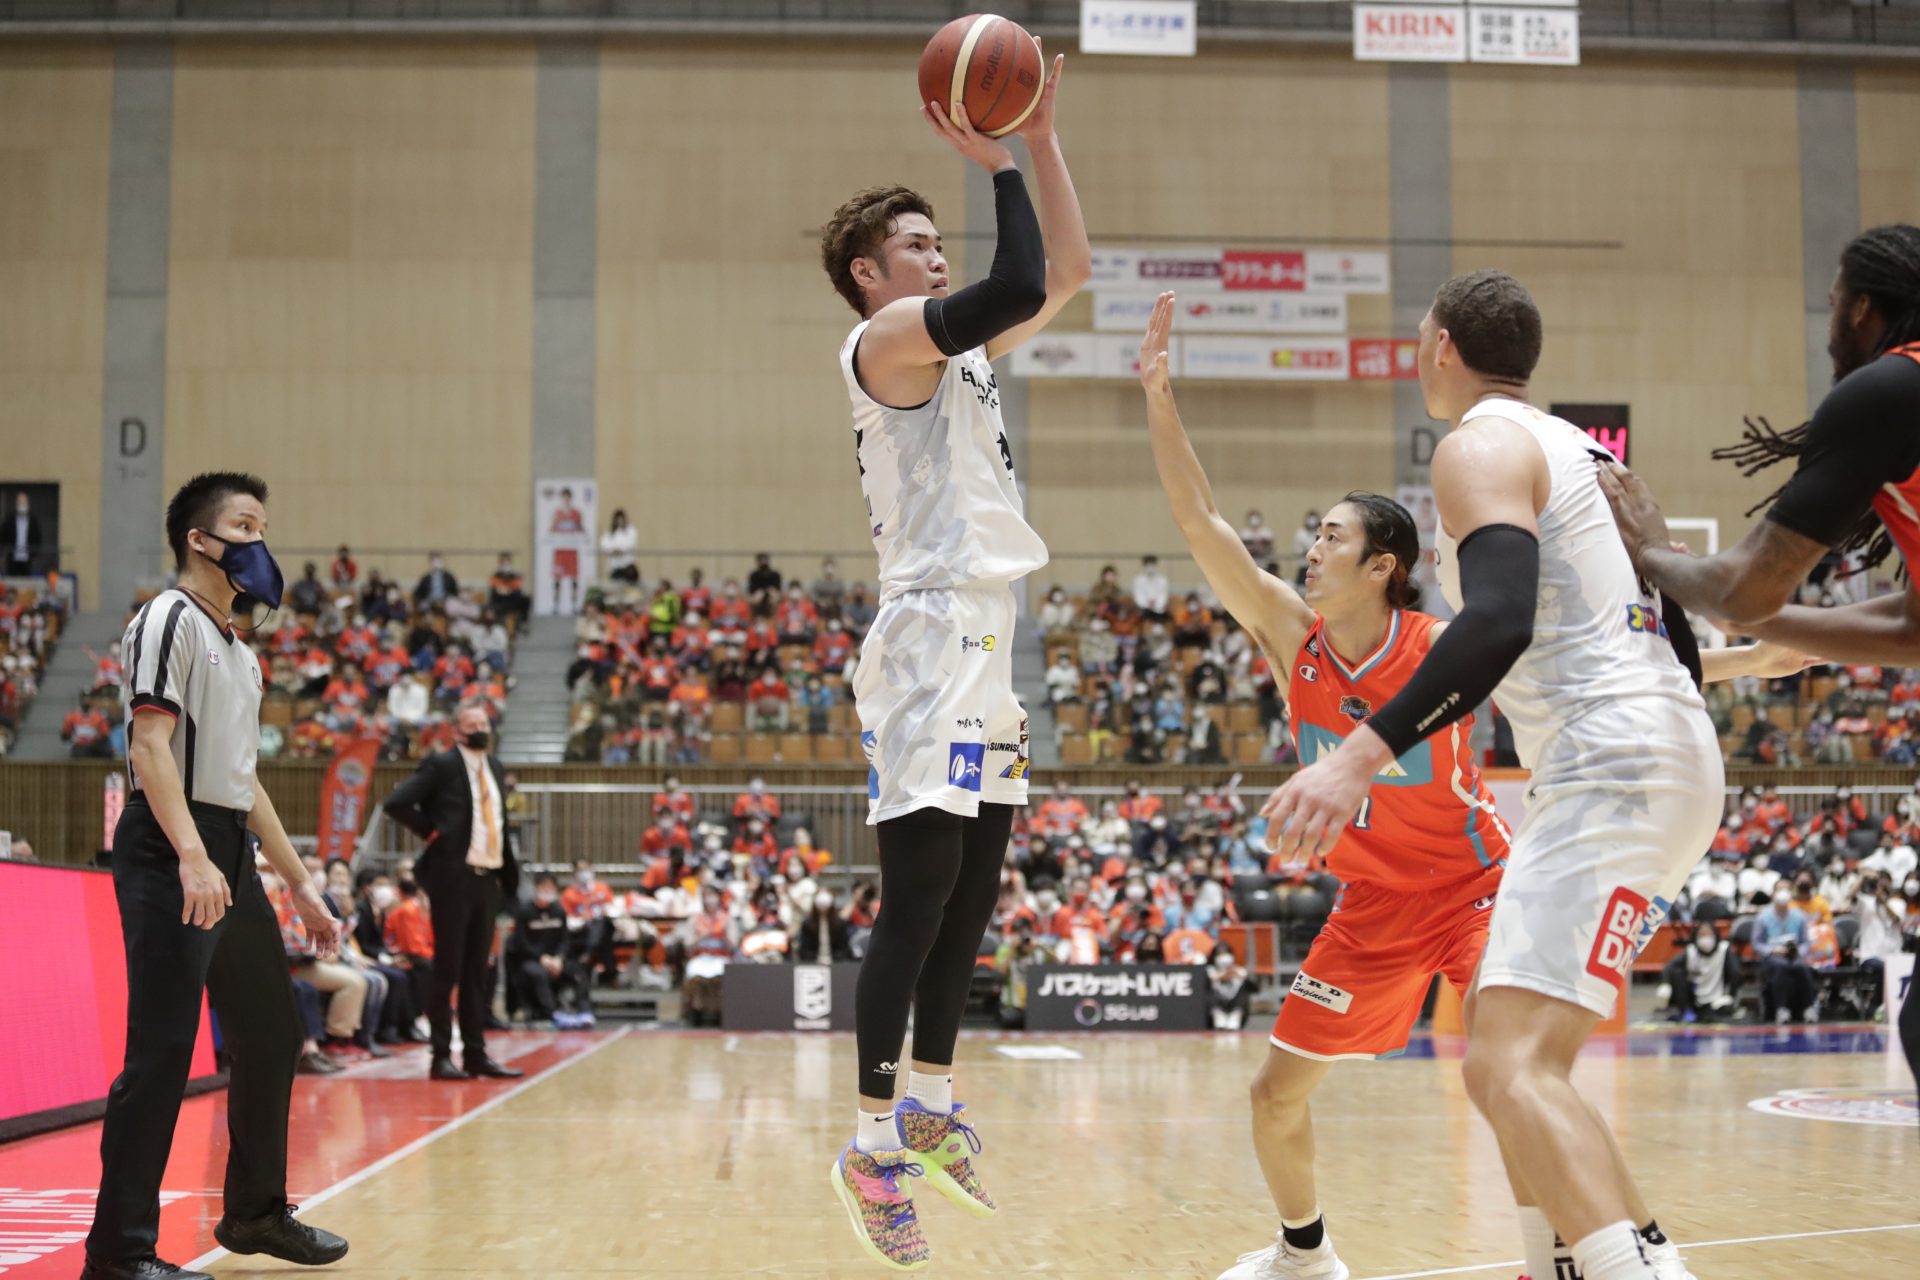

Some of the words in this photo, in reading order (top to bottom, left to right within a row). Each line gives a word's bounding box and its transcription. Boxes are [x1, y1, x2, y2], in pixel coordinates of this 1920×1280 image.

[1365, 14, 1455, 37] KIRIN
[980, 37, 1006, 92] molten
[120, 417, 146, 458] D
[1293, 981, 1332, 1005] Engineer
